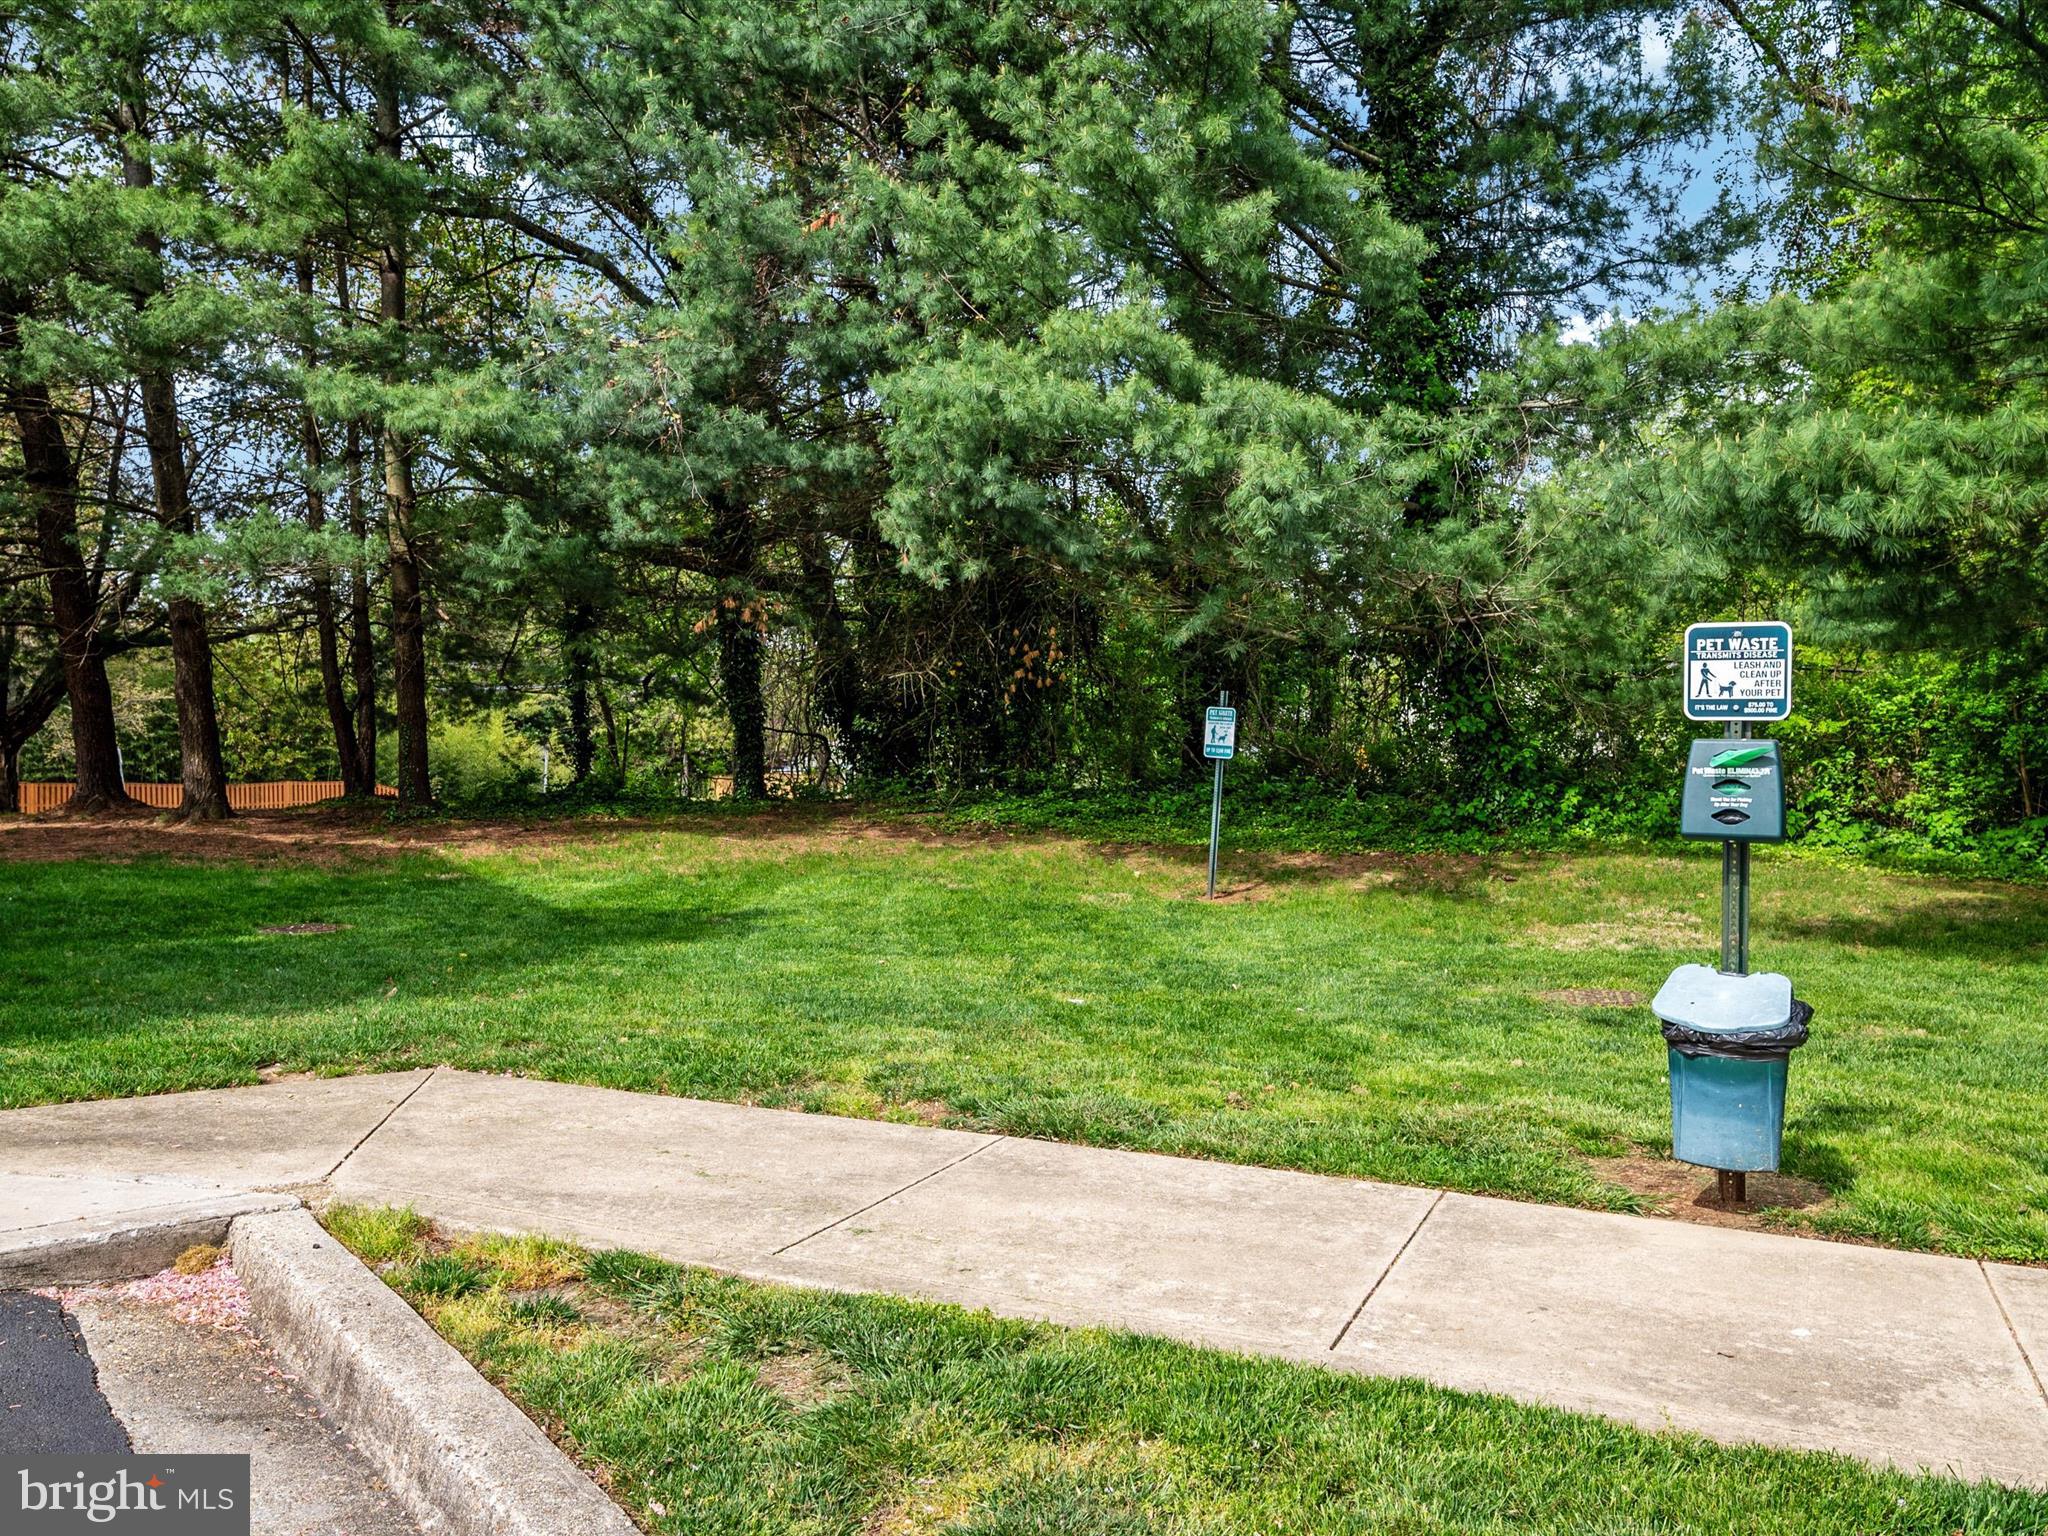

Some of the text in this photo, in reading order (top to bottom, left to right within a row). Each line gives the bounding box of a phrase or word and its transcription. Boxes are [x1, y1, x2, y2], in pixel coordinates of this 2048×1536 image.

[1696, 637, 1778, 651] PET WASTE
[1696, 650, 1778, 660] TRANSMITS DISEASE
[1734, 661, 1782, 669] LEASH AND
[1739, 670, 1782, 678] CLEAN UP
[1754, 680, 1782, 688] AFTER
[1740, 688, 1781, 697] YOUR PET
